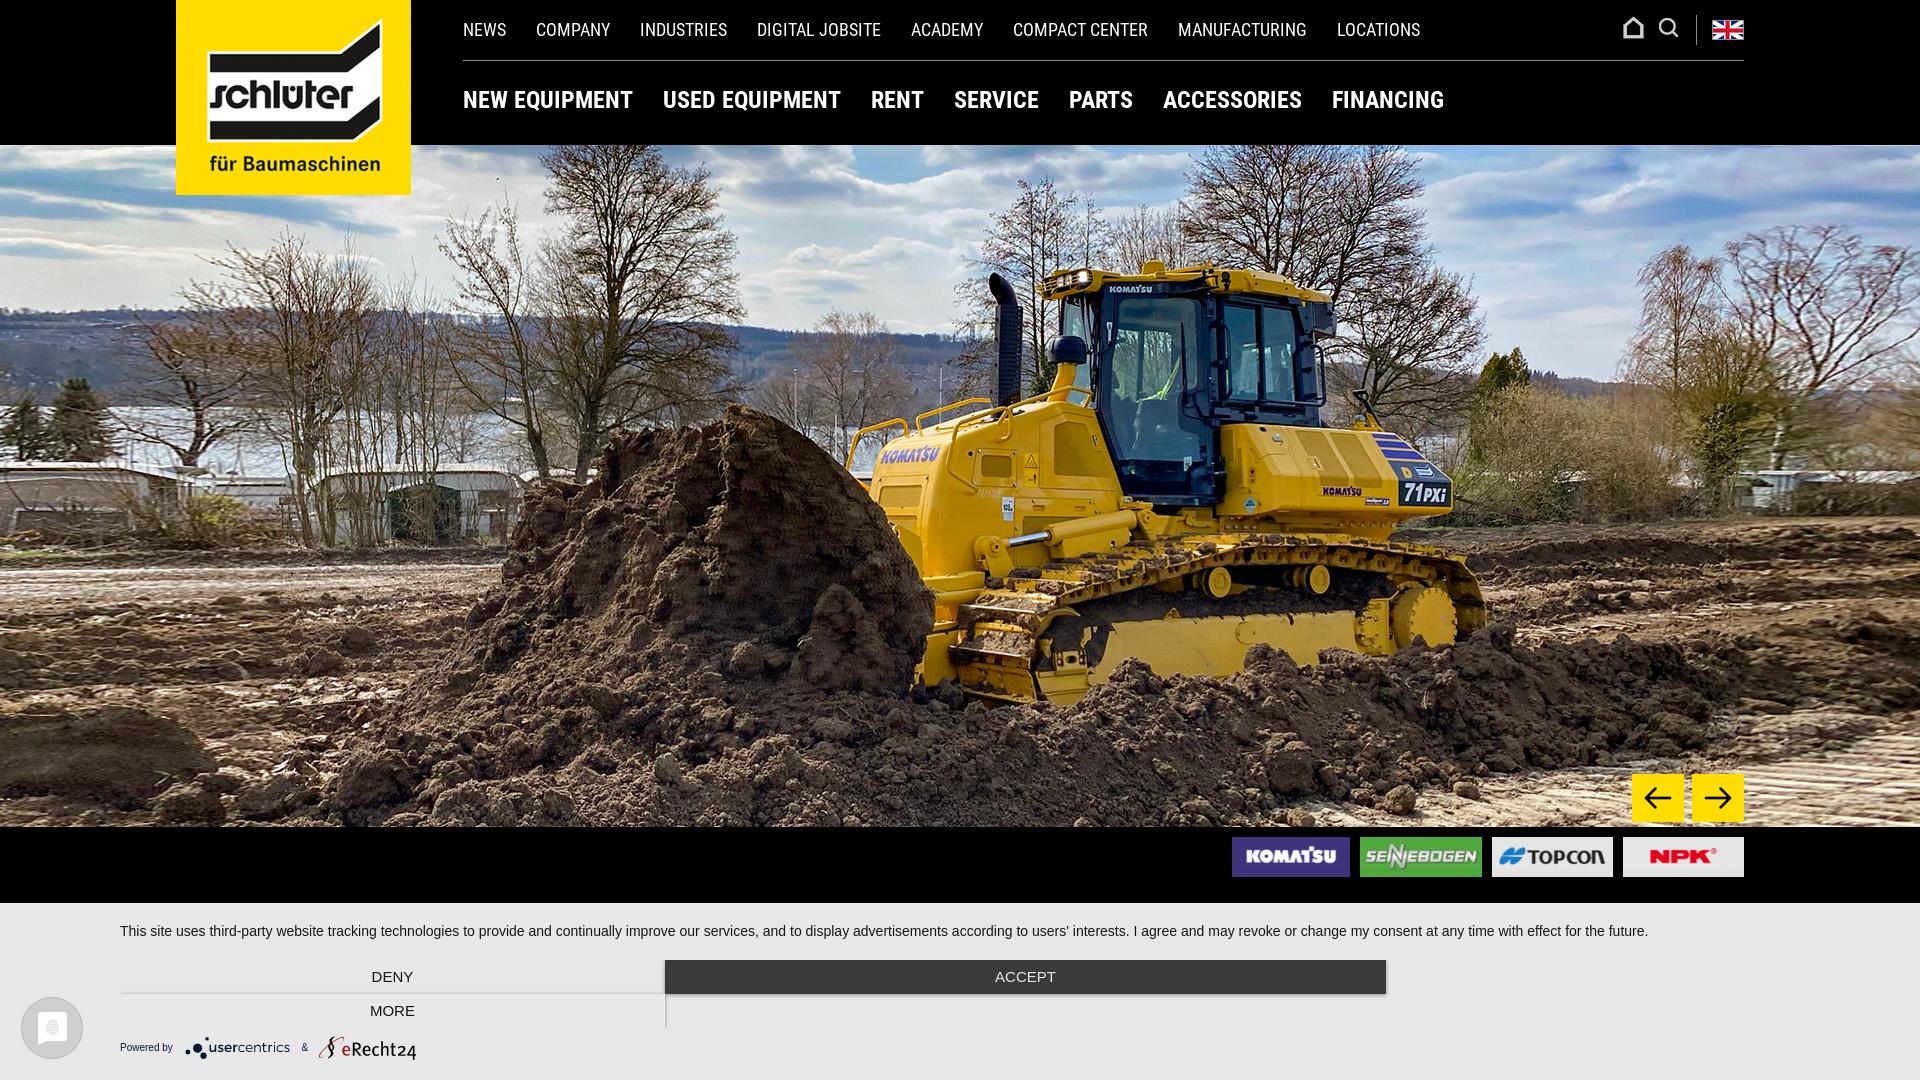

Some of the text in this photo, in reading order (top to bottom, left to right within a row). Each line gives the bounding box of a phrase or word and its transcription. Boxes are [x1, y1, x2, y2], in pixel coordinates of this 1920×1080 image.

[463, 22, 507, 37] NEWS
[536, 22, 611, 37] COMPANY
[640, 22, 728, 37] INDUSTRIES
[757, 22, 881, 37] DIGITAL JOBSITE
[910, 22, 984, 37] ACADEMY
[1013, 22, 1148, 37] COMPACT CENTER
[1178, 22, 1307, 37] MANUFACTURING
[1337, 22, 1421, 37] LOCATIONS
[209, 79, 354, 110] schlüter
[463, 90, 634, 112] NEW EQUIPMENT
[663, 90, 842, 112] USED EQUIPMENT
[871, 90, 925, 109] RENT
[954, 90, 1039, 109] SERVICE
[1069, 90, 1133, 109] PARTS
[1162, 90, 1302, 109] ACCESSORIES
[1332, 90, 1444, 109] FINANCING
[209, 153, 382, 174] für Baumaschinen
[1109, 284, 1153, 294] KOMATSU
[879, 444, 940, 465] KOMATSU
[1400, 466, 1413, 479] D
[1322, 485, 1362, 496] KOMATSU
[1404, 482, 1447, 503] 71PXi
[1245, 845, 1337, 864] KOMATSU
[1366, 843, 1478, 869] SENNEBOGEN
[1526, 849, 1606, 865] TOPCON
[119, 924, 1648, 940] This site uses third-party website tracking technologies to provide and continually improve our services, and to display advertisements according to users' interests. I agree and may revoke or change my consent at any time with effect for the future.
[371, 971, 414, 983] DENY
[994, 971, 1057, 983] ACCEPT
[370, 1005, 416, 1017] MORE
[120, 1042, 174, 1054] Powered by
[208, 1041, 291, 1053] usercentrics
[301, 1042, 309, 1052] &
[341, 1041, 417, 1061] eRecht24
